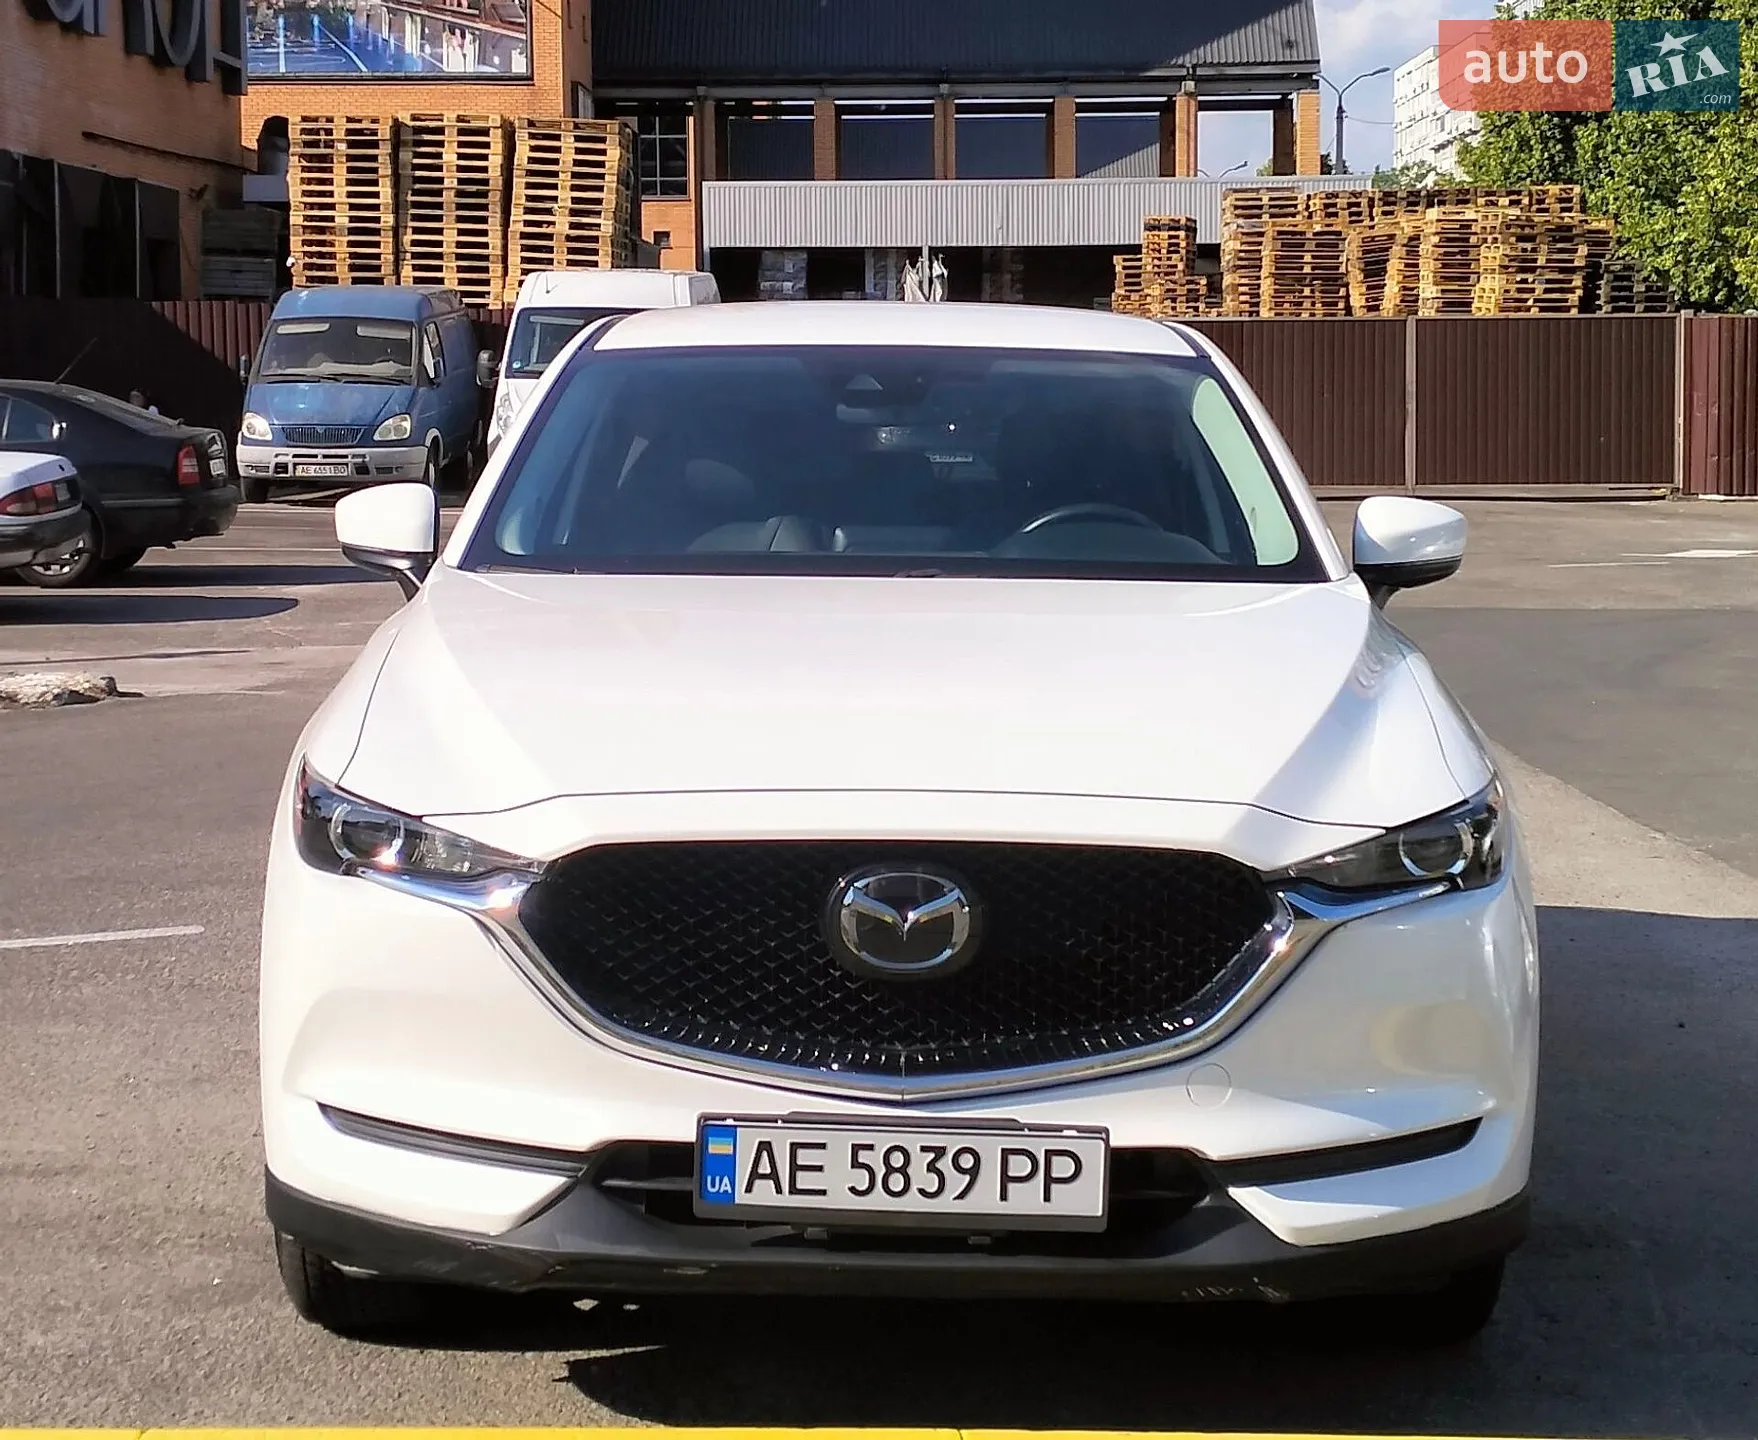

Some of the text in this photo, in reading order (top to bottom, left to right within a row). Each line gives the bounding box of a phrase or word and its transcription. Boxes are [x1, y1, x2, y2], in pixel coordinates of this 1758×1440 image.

[301, 466, 312, 475] AE
[744, 1140, 1083, 1203] AE 5839 PP
[707, 1174, 732, 1193] UA
